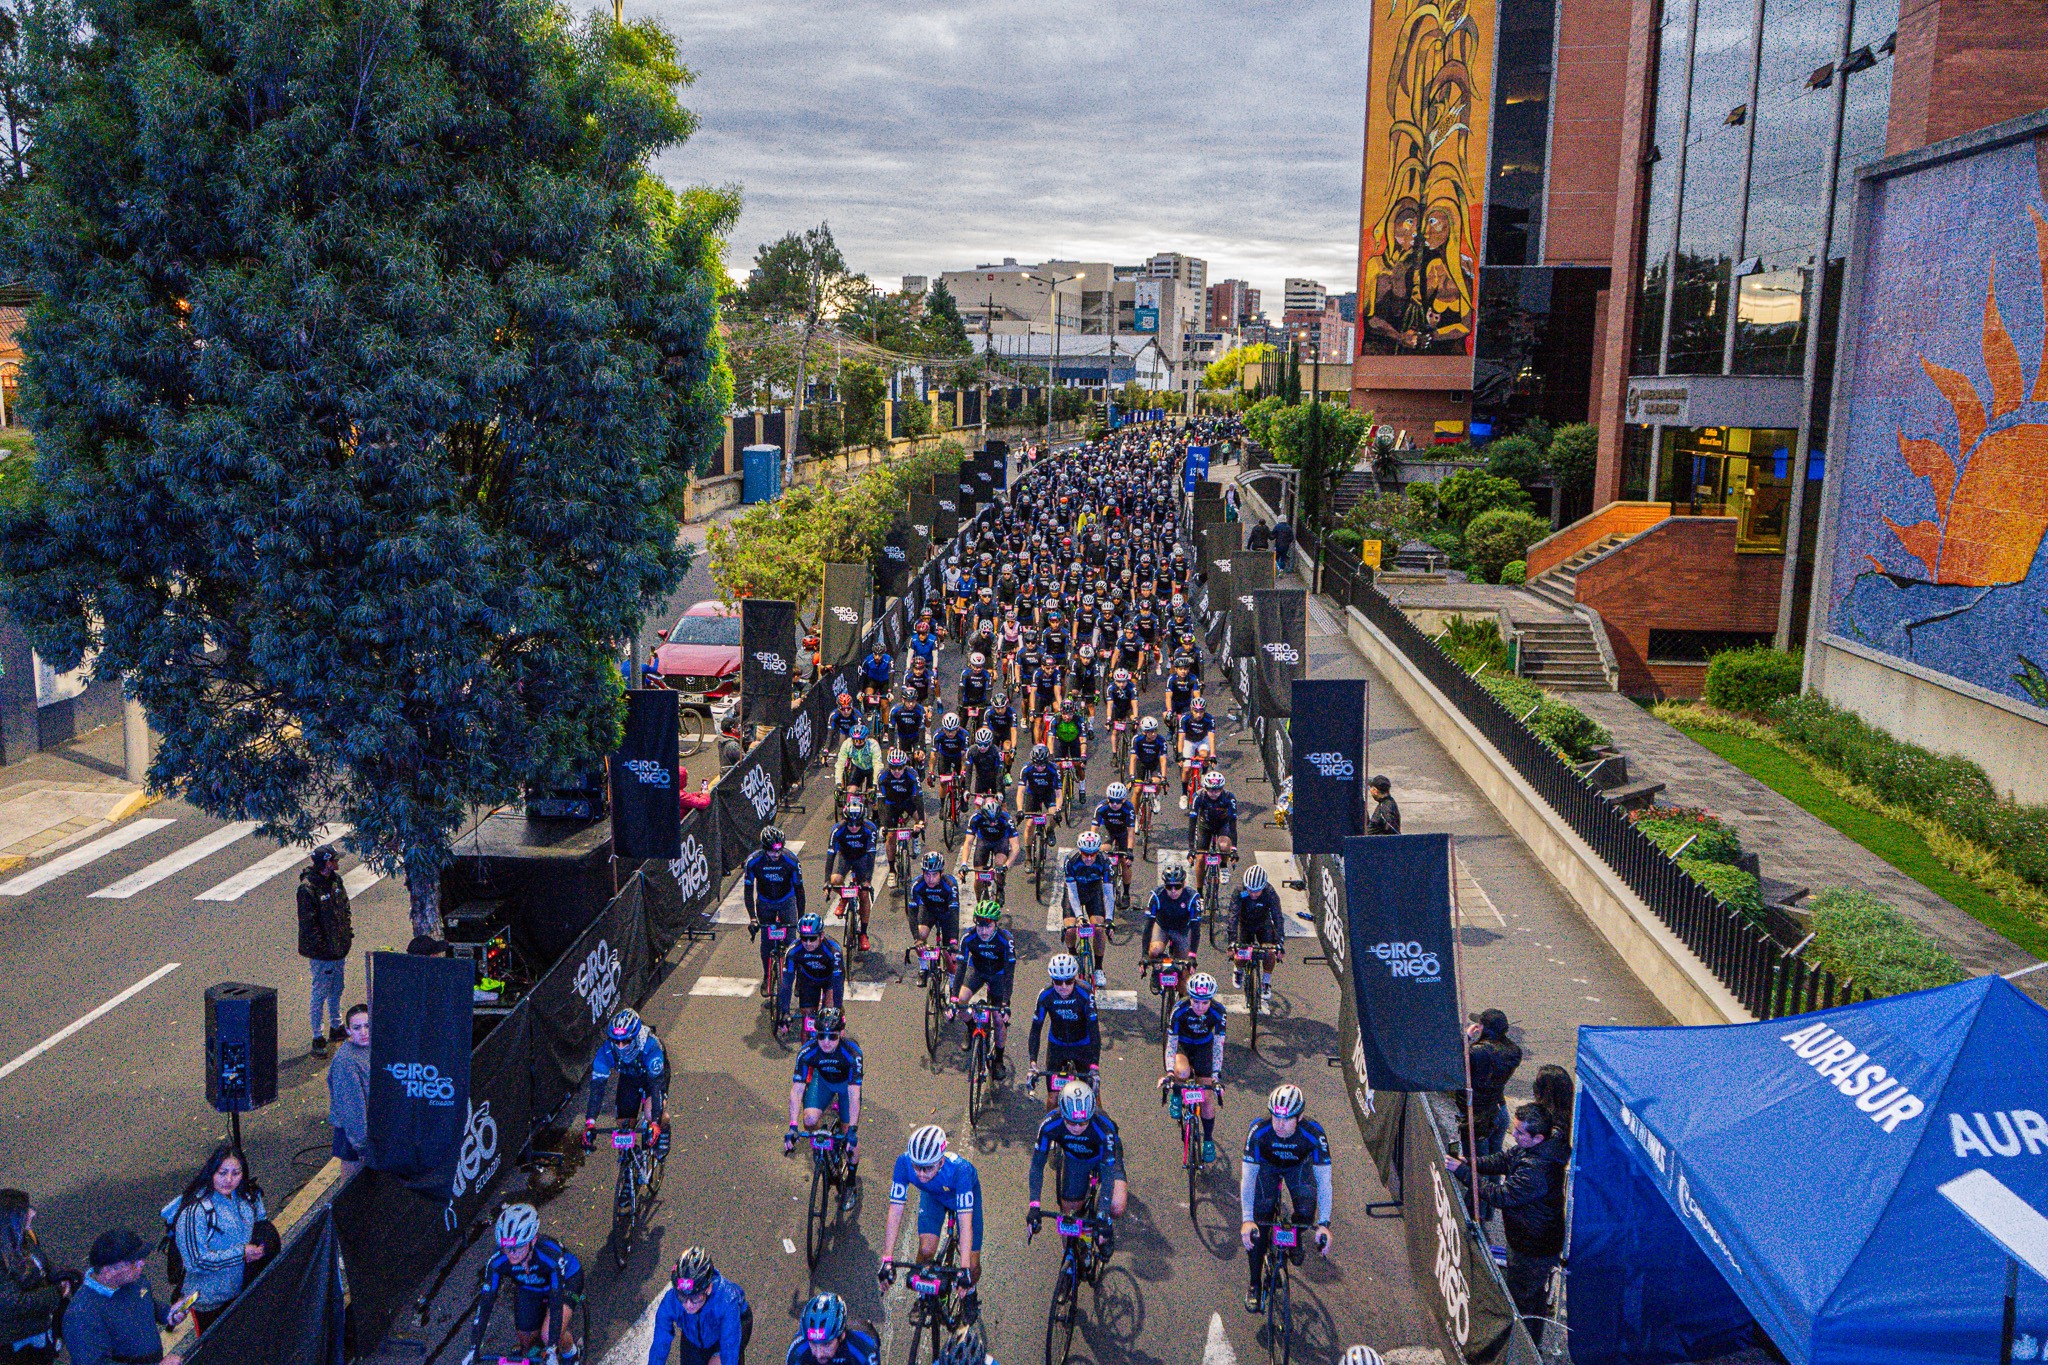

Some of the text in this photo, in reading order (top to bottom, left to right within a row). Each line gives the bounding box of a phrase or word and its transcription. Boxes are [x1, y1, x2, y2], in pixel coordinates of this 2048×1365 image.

[833, 606, 852, 614] GIRO
[838, 614, 858, 622] RIGO
[756, 651, 780, 661] GIRO
[1267, 643, 1290, 652] GIRO
[1275, 652, 1299, 662] RIGO
[763, 661, 787, 671] RIGO
[628, 759, 660, 772] GIRO
[1309, 752, 1343, 765] GIRO
[639, 771, 671, 784] RIGO
[1320, 763, 1354, 777] RIGO
[743, 763, 764, 799] GIRO
[754, 782, 775, 820] RIGO
[672, 834, 696, 878] GIRO
[681, 853, 709, 902] RIGO
[1376, 941, 1423, 960] GIRO
[577, 939, 608, 998] GIRO
[1391, 957, 1441, 978] RIGO
[591, 959, 621, 1025] RIGO
[391, 1062, 439, 1082] GIRO
[1779, 1022, 1925, 1134] AURASUR
[406, 1079, 455, 1100] RIGO
[1434, 1168, 1461, 1269] GIRO
[1434, 1234, 1471, 1346] RIGO
